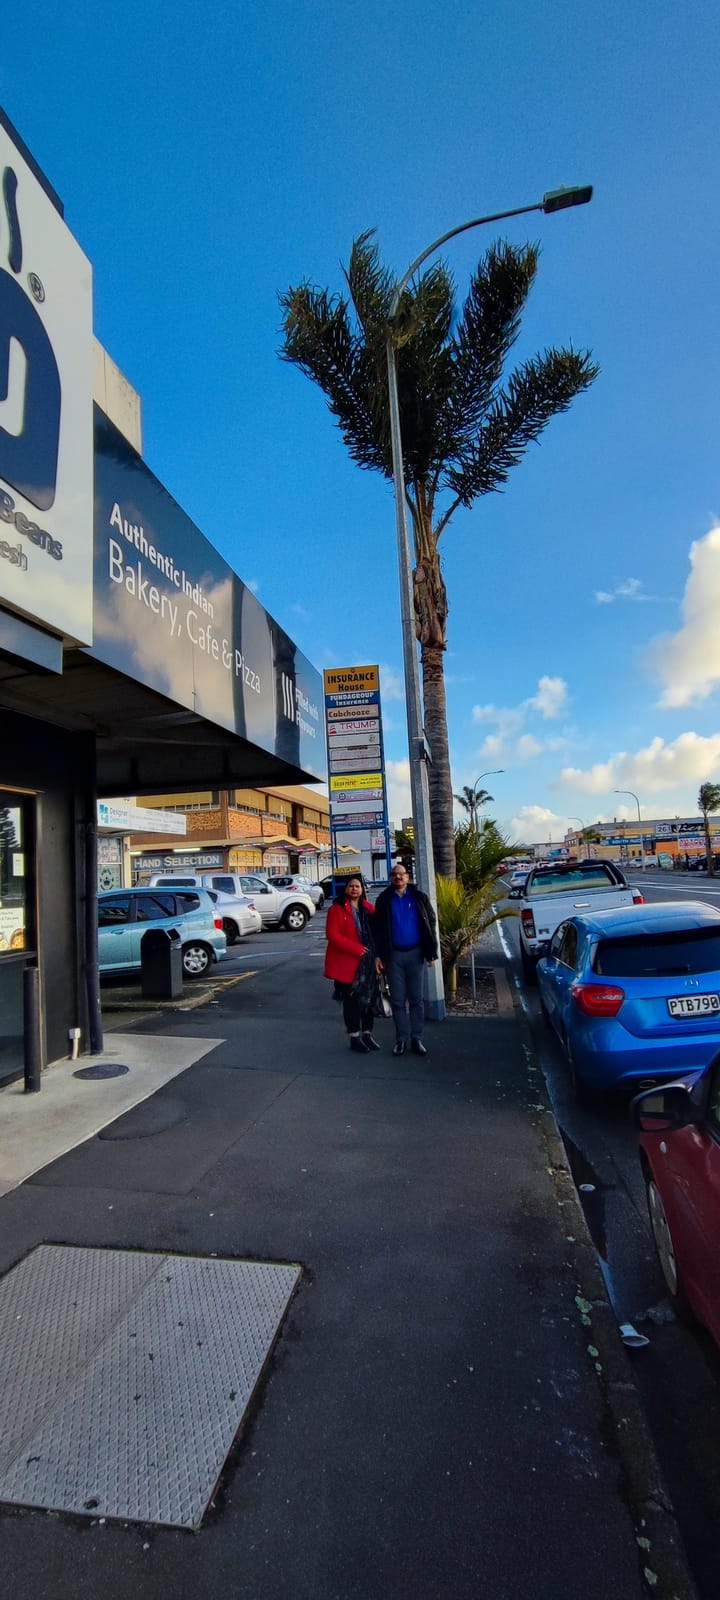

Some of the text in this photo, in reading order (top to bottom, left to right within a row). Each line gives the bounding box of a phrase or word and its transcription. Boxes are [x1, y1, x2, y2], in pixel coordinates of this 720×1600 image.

[109, 502, 214, 619] Authentic Indian
[109, 538, 261, 693] Bakery, Cafe & Pizza
[327, 672, 375, 684] INSURANCE
[338, 683, 365, 691] House
[339, 720, 377, 729] TRUMP
[134, 858, 161, 868] HAND
[163, 855, 220, 867] SELECTION
[670, 996, 719, 1013] PTB790
